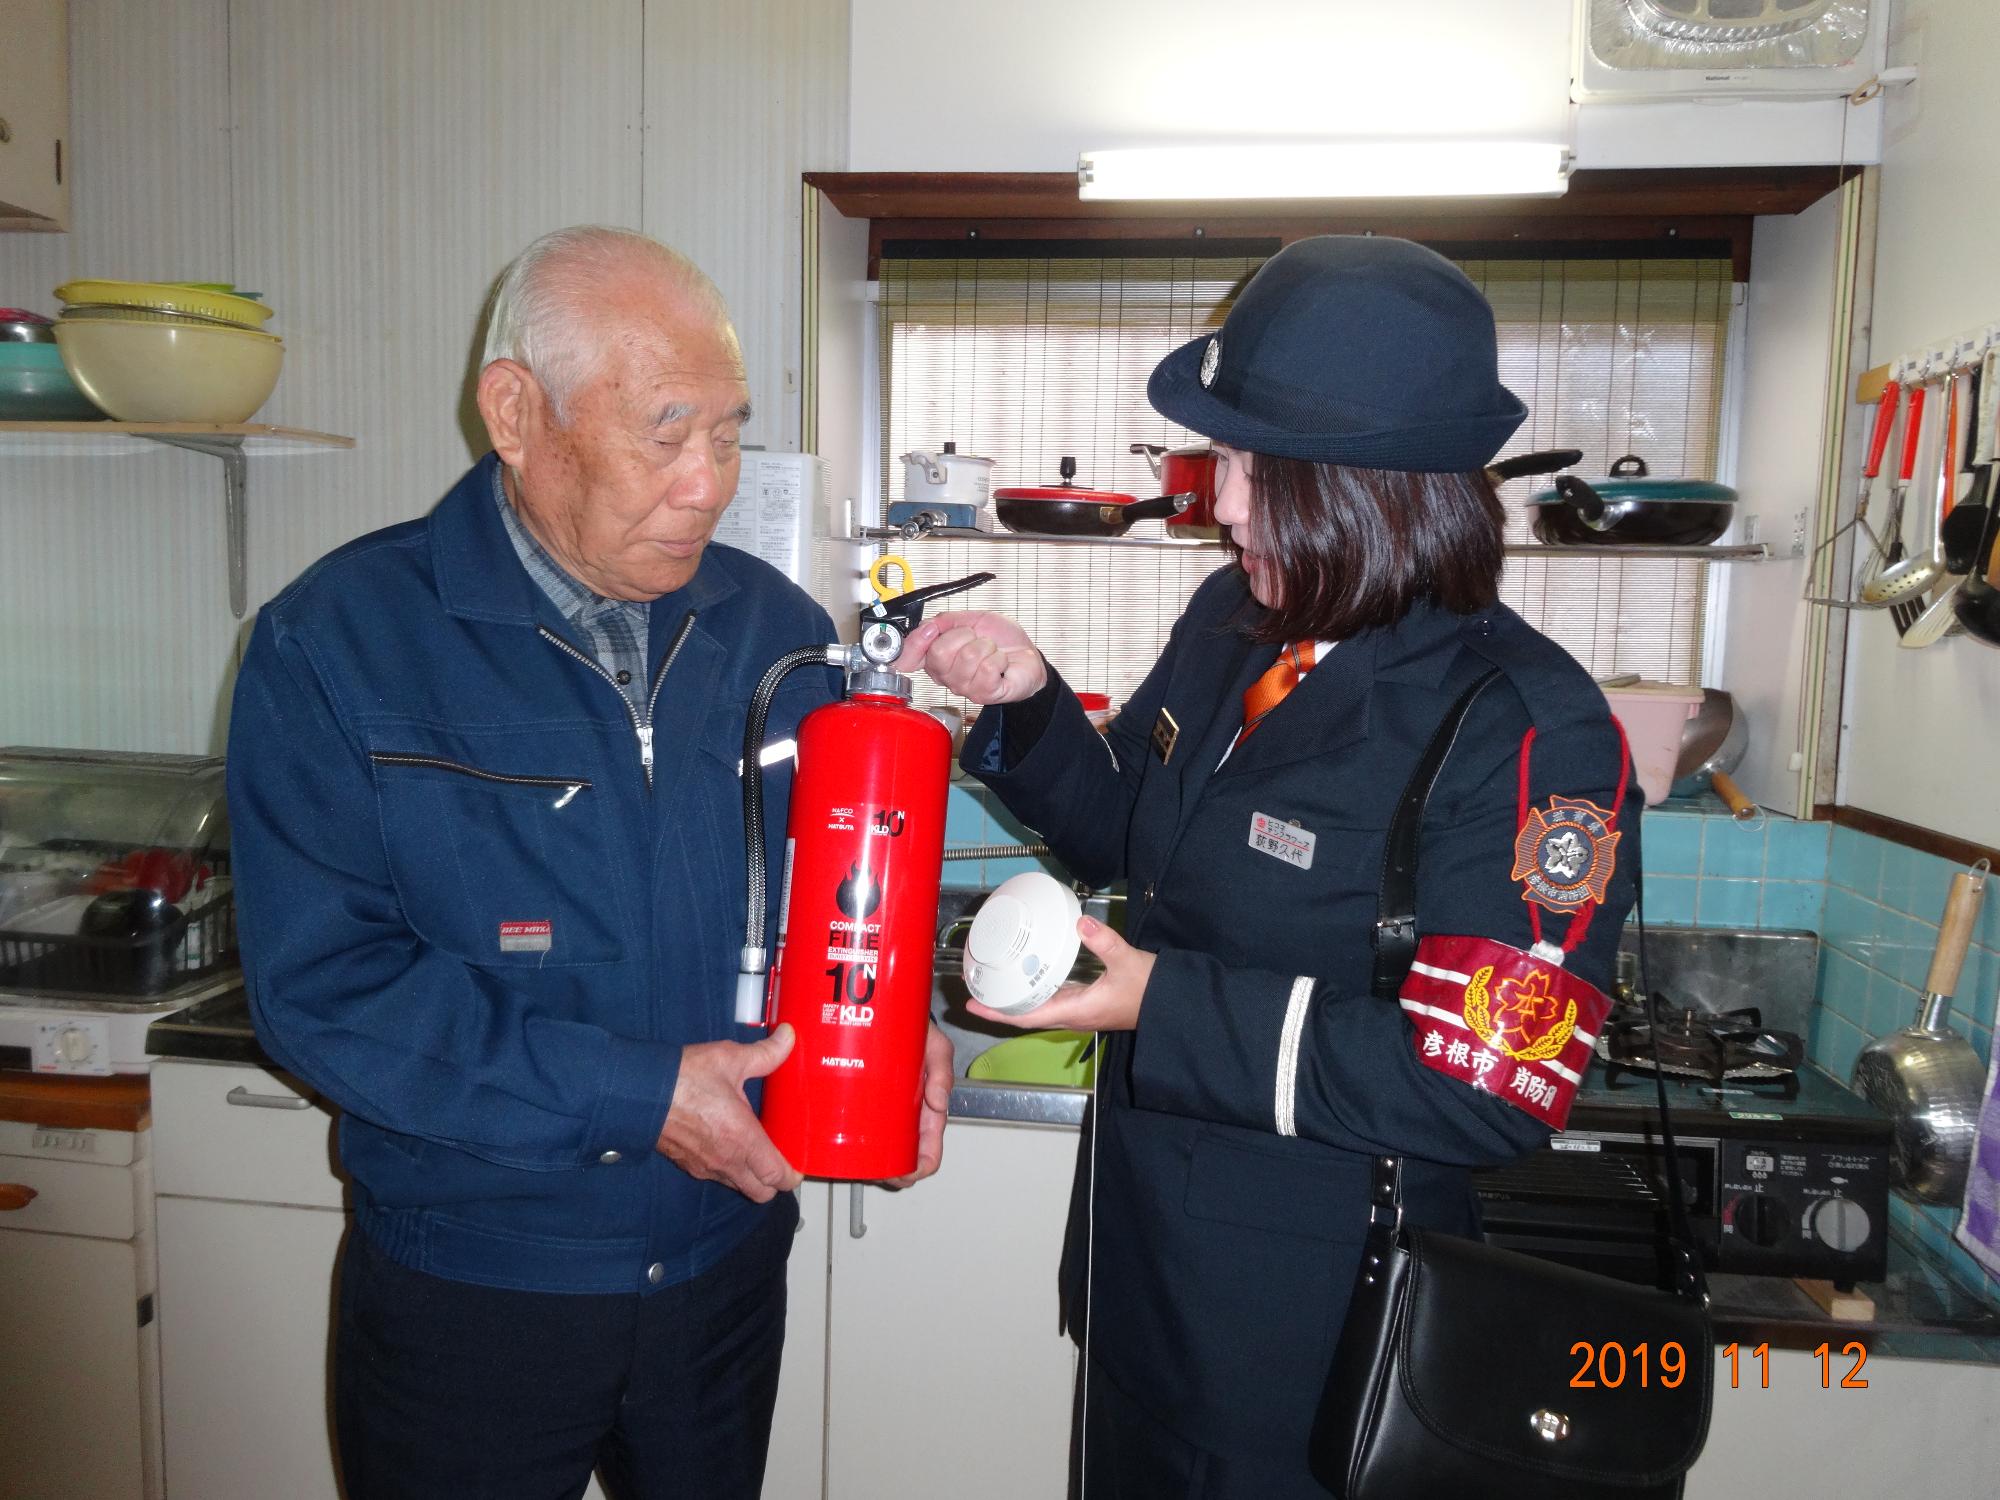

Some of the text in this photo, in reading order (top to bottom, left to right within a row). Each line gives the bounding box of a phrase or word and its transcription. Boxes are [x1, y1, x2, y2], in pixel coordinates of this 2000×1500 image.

[829, 930, 879, 950] FIRE
[826, 963, 876, 1004] 10
[840, 1005, 874, 1022] KLD
[822, 1056, 865, 1068] HATSUTA
[1423, 1030, 1498, 1077] 彦根市
